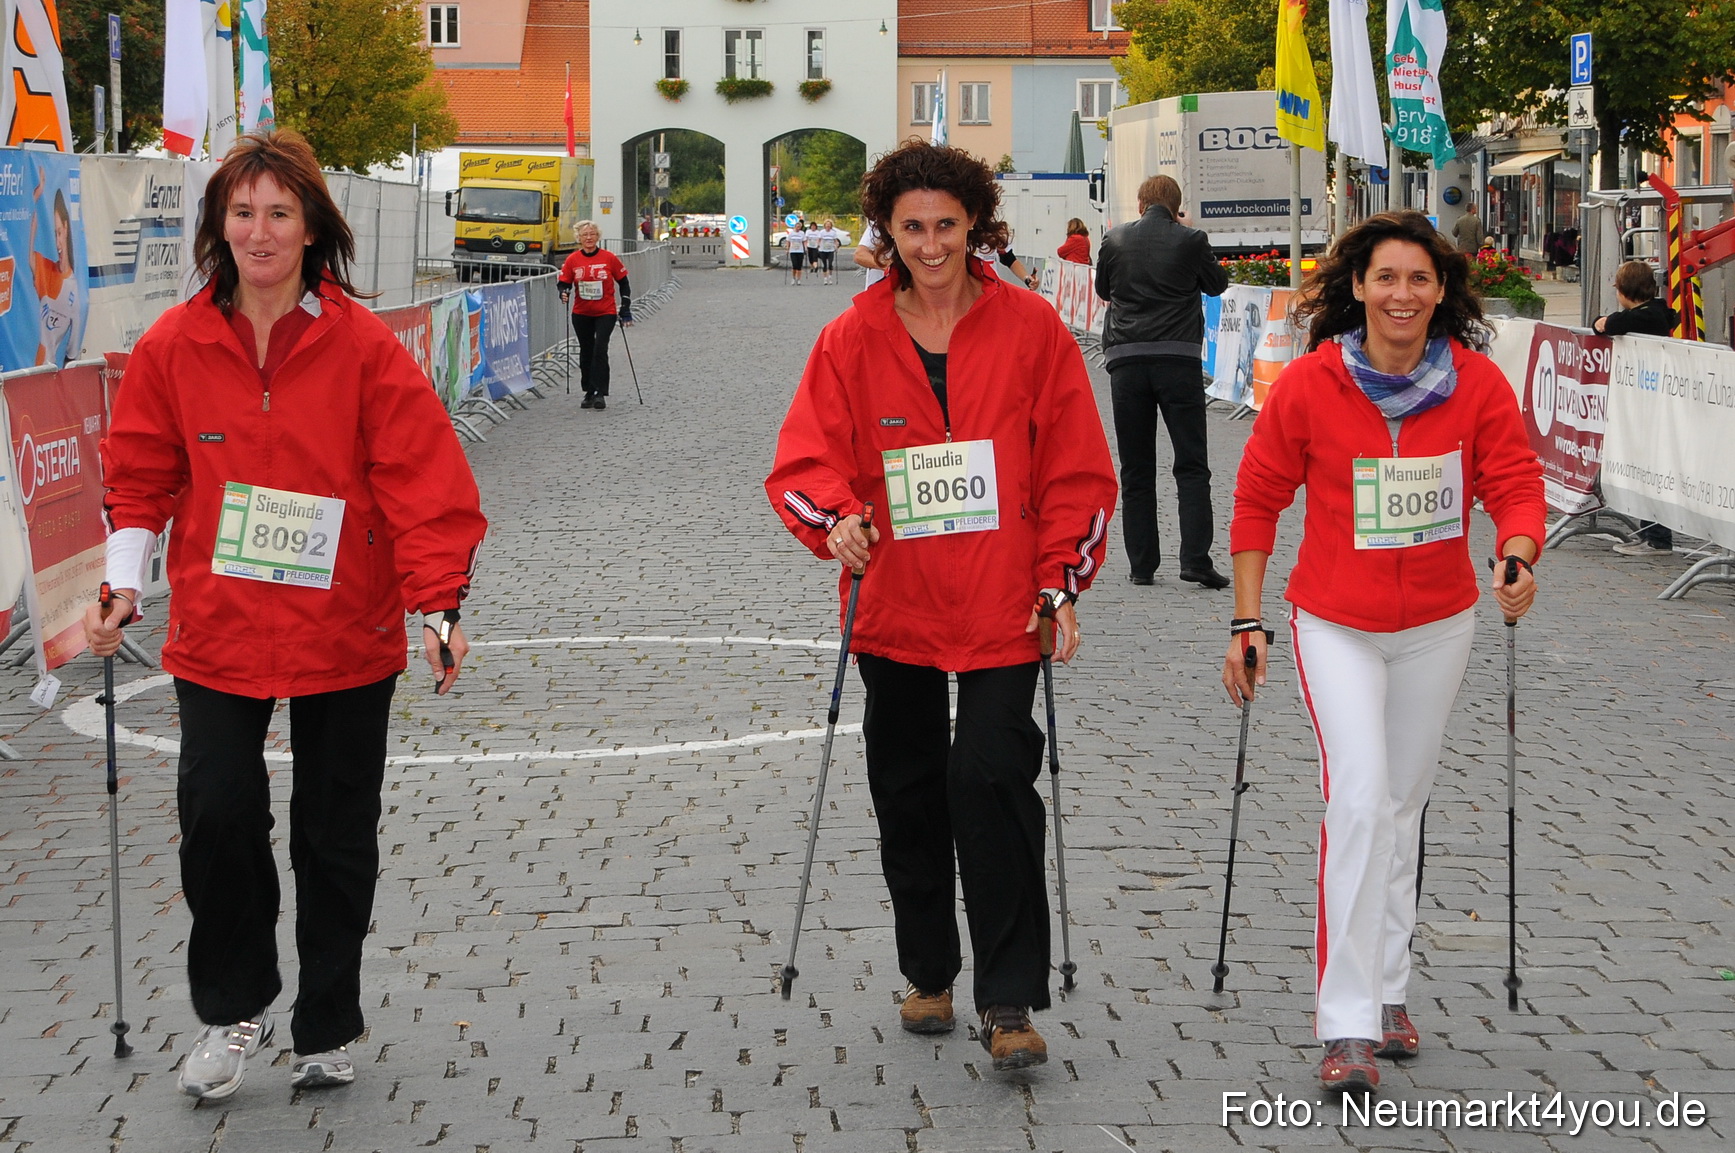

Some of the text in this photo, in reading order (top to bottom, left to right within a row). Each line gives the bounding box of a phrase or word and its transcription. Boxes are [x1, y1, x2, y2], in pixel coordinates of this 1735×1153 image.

[1576, 40, 1587, 78] P
[1199, 126, 1305, 151] BOC
[1204, 203, 1309, 215] www.bockonlinee
[912, 450, 962, 470] Claudia
[1384, 464, 1442, 482] Manuela
[916, 475, 986, 505] 8060
[256, 494, 324, 520] Sieglinde
[1387, 486, 1454, 517] 8080
[956, 516, 996, 526] PFLEIDERER
[1424, 522, 1460, 537] PFLEIDERER
[252, 524, 328, 558] 8092
[286, 570, 330, 583] PFLEIDERER
